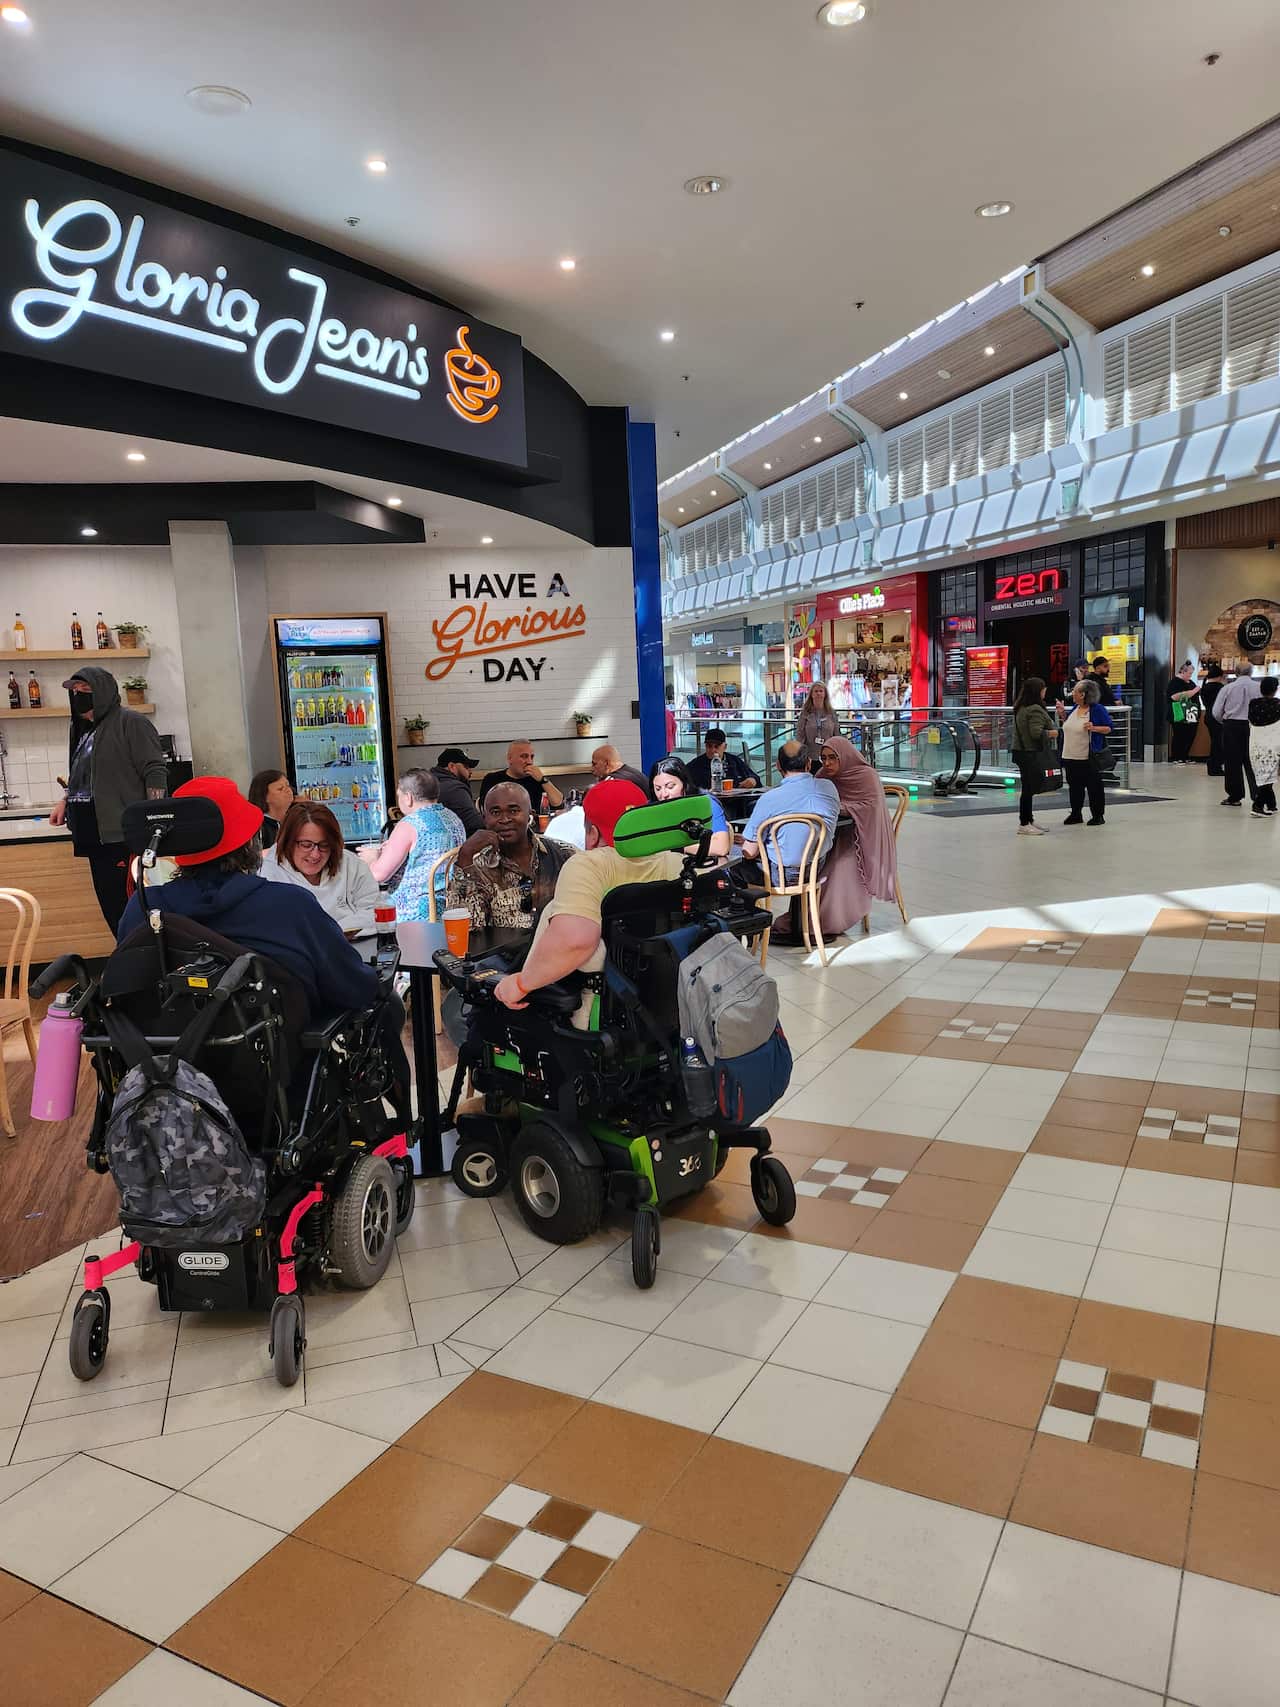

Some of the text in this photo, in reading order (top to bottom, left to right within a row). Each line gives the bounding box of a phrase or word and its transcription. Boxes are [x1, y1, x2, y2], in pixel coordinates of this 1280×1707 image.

[11, 198, 430, 400] Gloria Jean's
[449, 572, 571, 599] HAVE A
[995, 568, 1060, 600] zen
[862, 592, 886, 611] Place
[1034, 596, 1054, 605] HEALTH
[424, 601, 587, 681] Glorious
[482, 656, 547, 683] DAY
[183, 1256, 222, 1265] GLIDE
